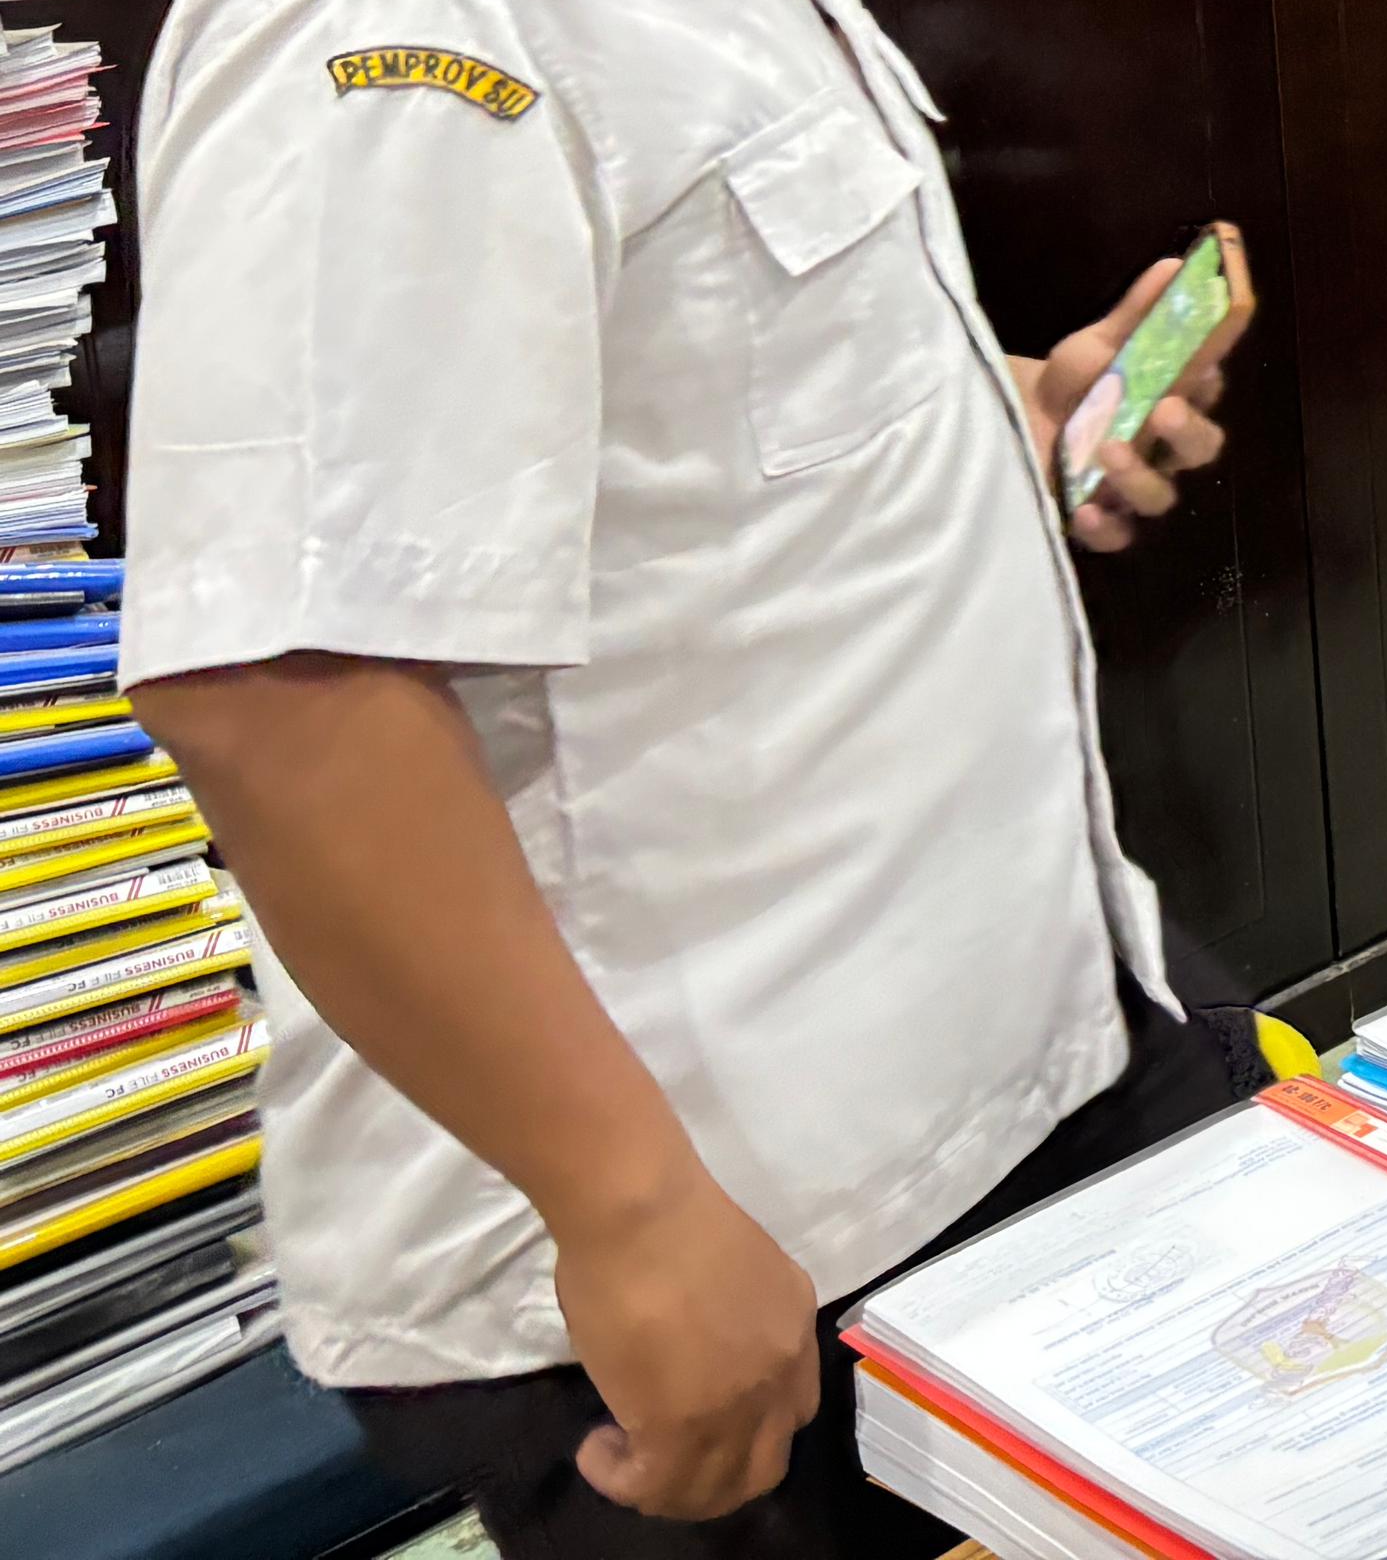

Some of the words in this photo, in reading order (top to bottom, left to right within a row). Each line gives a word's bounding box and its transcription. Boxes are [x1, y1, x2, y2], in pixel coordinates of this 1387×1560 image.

[340, 52, 487, 90] PEMPROV
[32, 807, 104, 831] BUSINESS
[49, 892, 119, 917] BUSINESS
[125, 948, 195, 976] BUSINESS
[68, 980, 86, 992] FC
[70, 1003, 141, 1032] BUSINESS
[11, 1038, 31, 1051] FC
[162, 1047, 229, 1078] BUSINESS
[105, 1086, 125, 1099] FC
